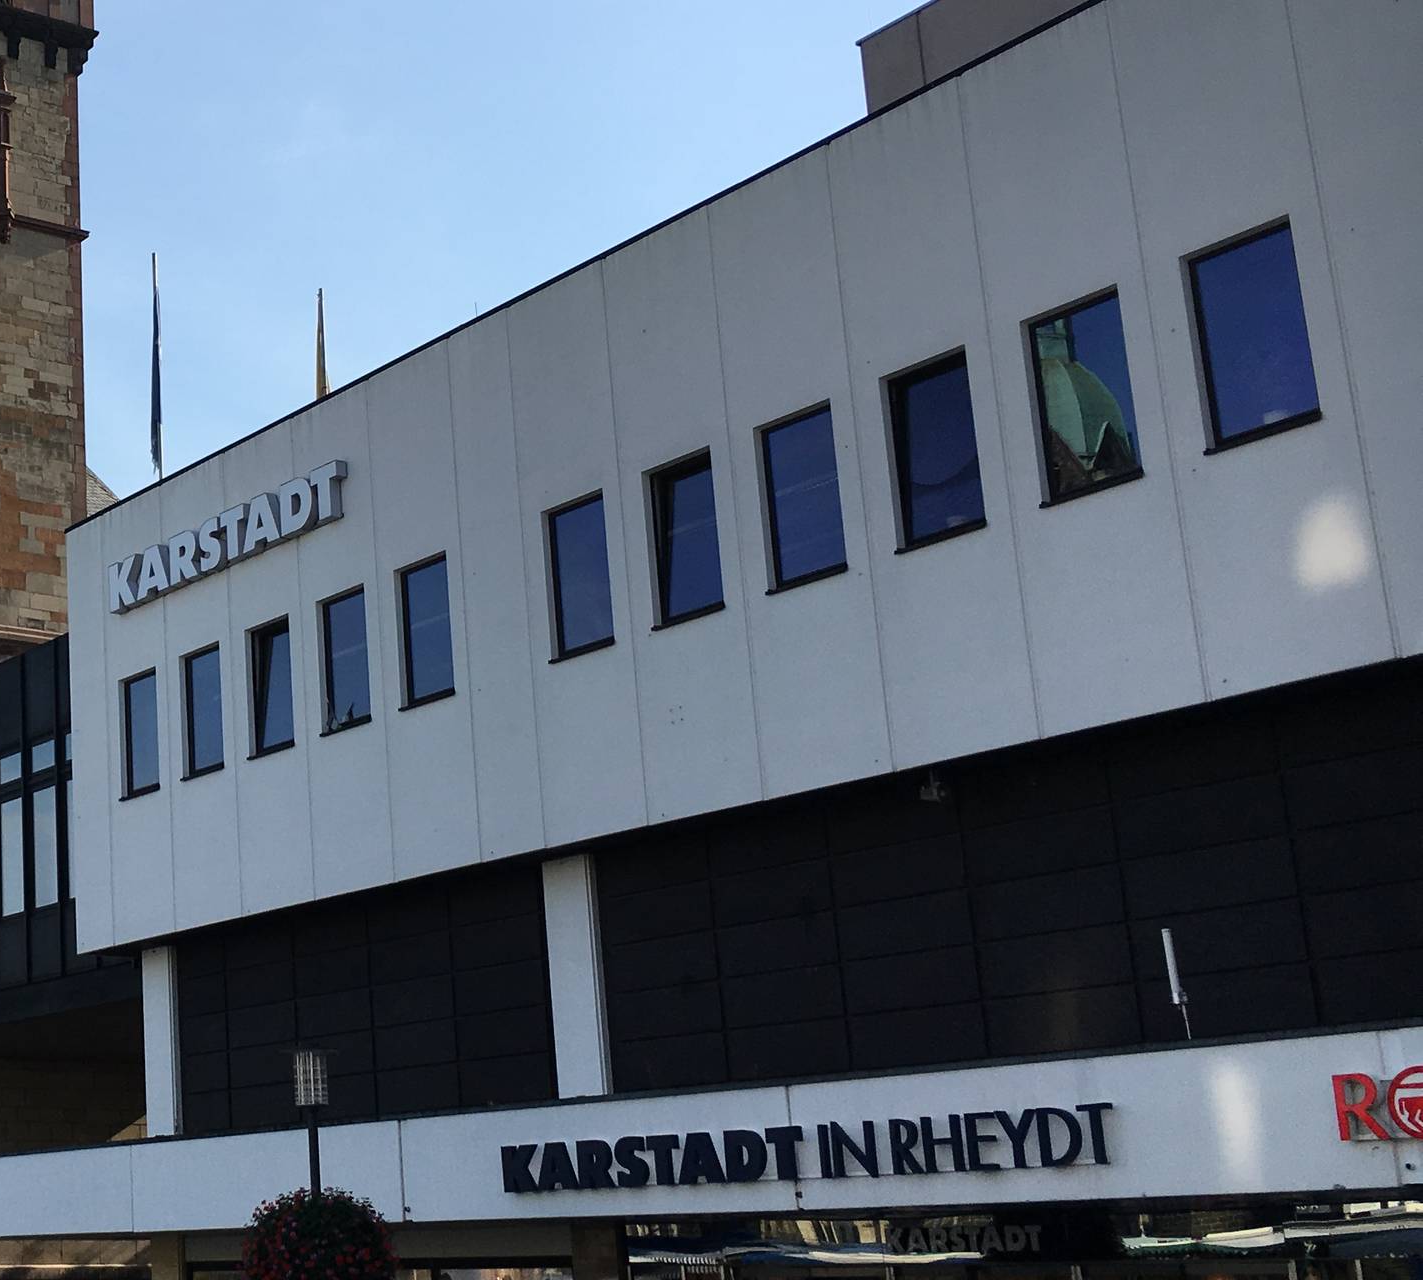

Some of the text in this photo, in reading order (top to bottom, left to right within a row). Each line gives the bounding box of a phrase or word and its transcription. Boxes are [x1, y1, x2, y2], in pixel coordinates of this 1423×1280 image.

[108, 460, 348, 615] KARSTADT
[500, 1102, 1113, 1193] KARSTADT IN RHEYDT
[887, 1224, 1042, 1253] KARSTADT
